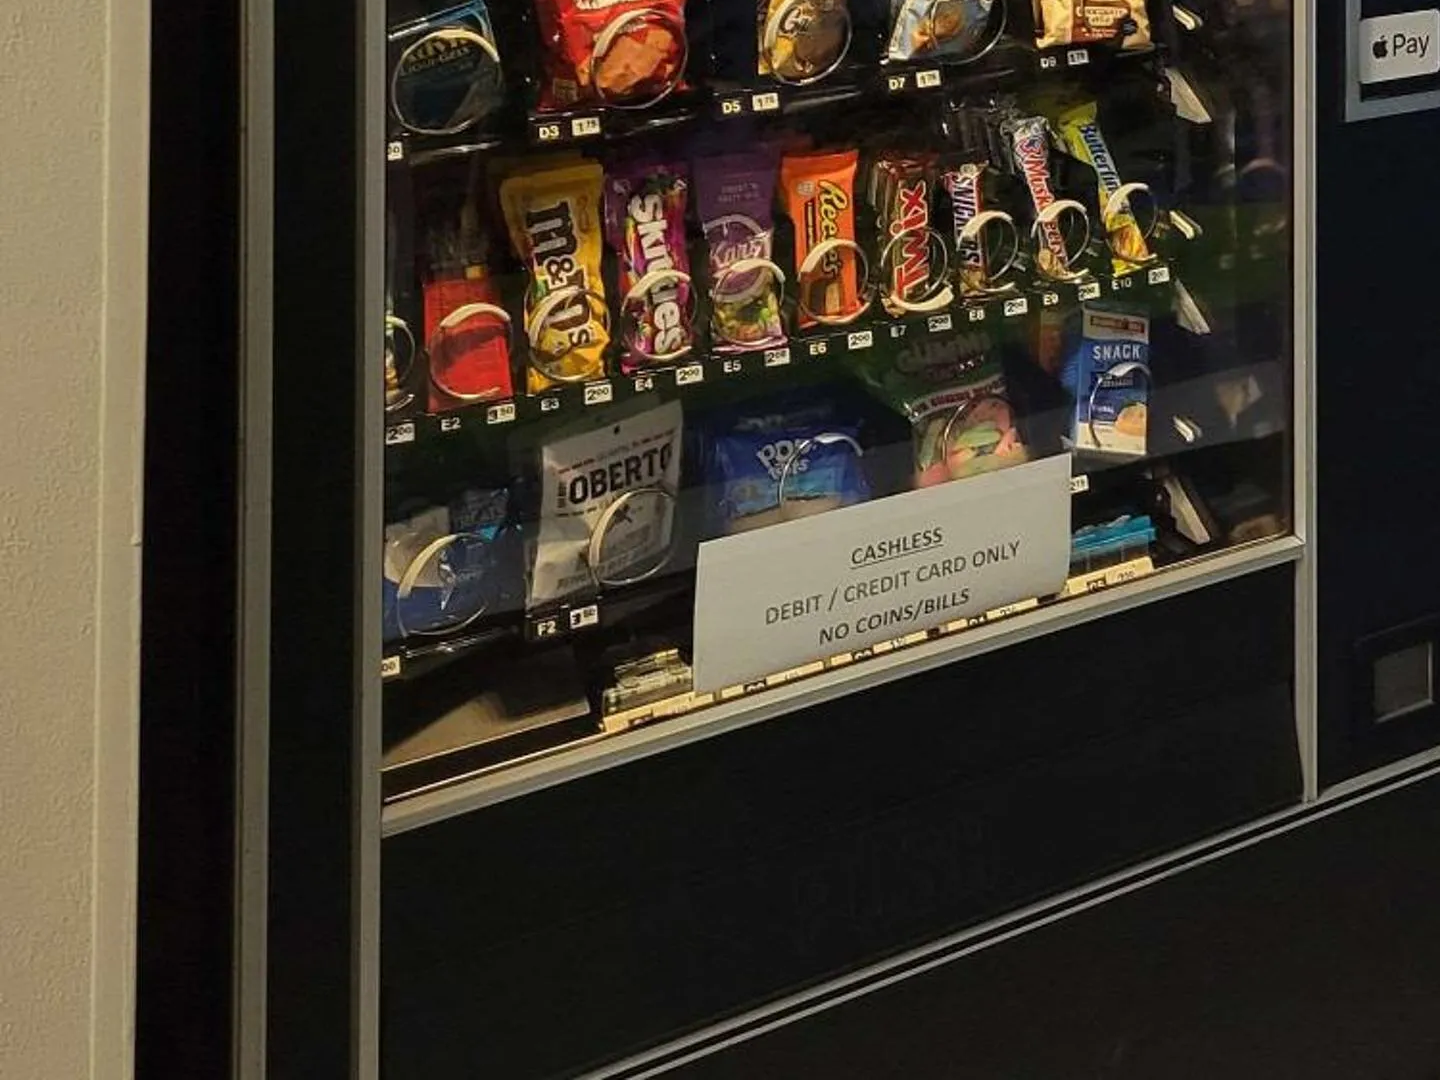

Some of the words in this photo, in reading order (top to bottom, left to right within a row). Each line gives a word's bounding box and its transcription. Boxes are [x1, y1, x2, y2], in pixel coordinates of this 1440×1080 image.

[1393, 32, 1430, 58] Pay
[889, 76, 906, 91] D7
[722, 100, 742, 114] D5
[539, 125, 560, 139] D3
[1111, 277, 1132, 290] E10
[969, 309, 986, 322] E8
[1005, 301, 1025, 314] 200
[809, 342, 828, 356] E6
[849, 333, 871, 347] 200
[1092, 343, 1141, 361] SNACK
[723, 360, 742, 373] E5
[767, 350, 788, 364] 200
[635, 377, 653, 392] E4
[678, 367, 702, 383] 200
[586, 386, 610, 402] 200
[441, 418, 461, 432] E2
[568, 441, 675, 506] OBERTO
[851, 526, 944, 567] CASHLESS
[764, 593, 823, 625] DEBIT
[827, 586, 839, 612] /
[843, 570, 910, 604] CREDIT
[915, 555, 967, 583] CARD
[972, 539, 1021, 568] ONLY
[818, 625, 850, 647] NO
[855, 587, 971, 634] COINS/BILLS
[537, 621, 556, 637] F2
